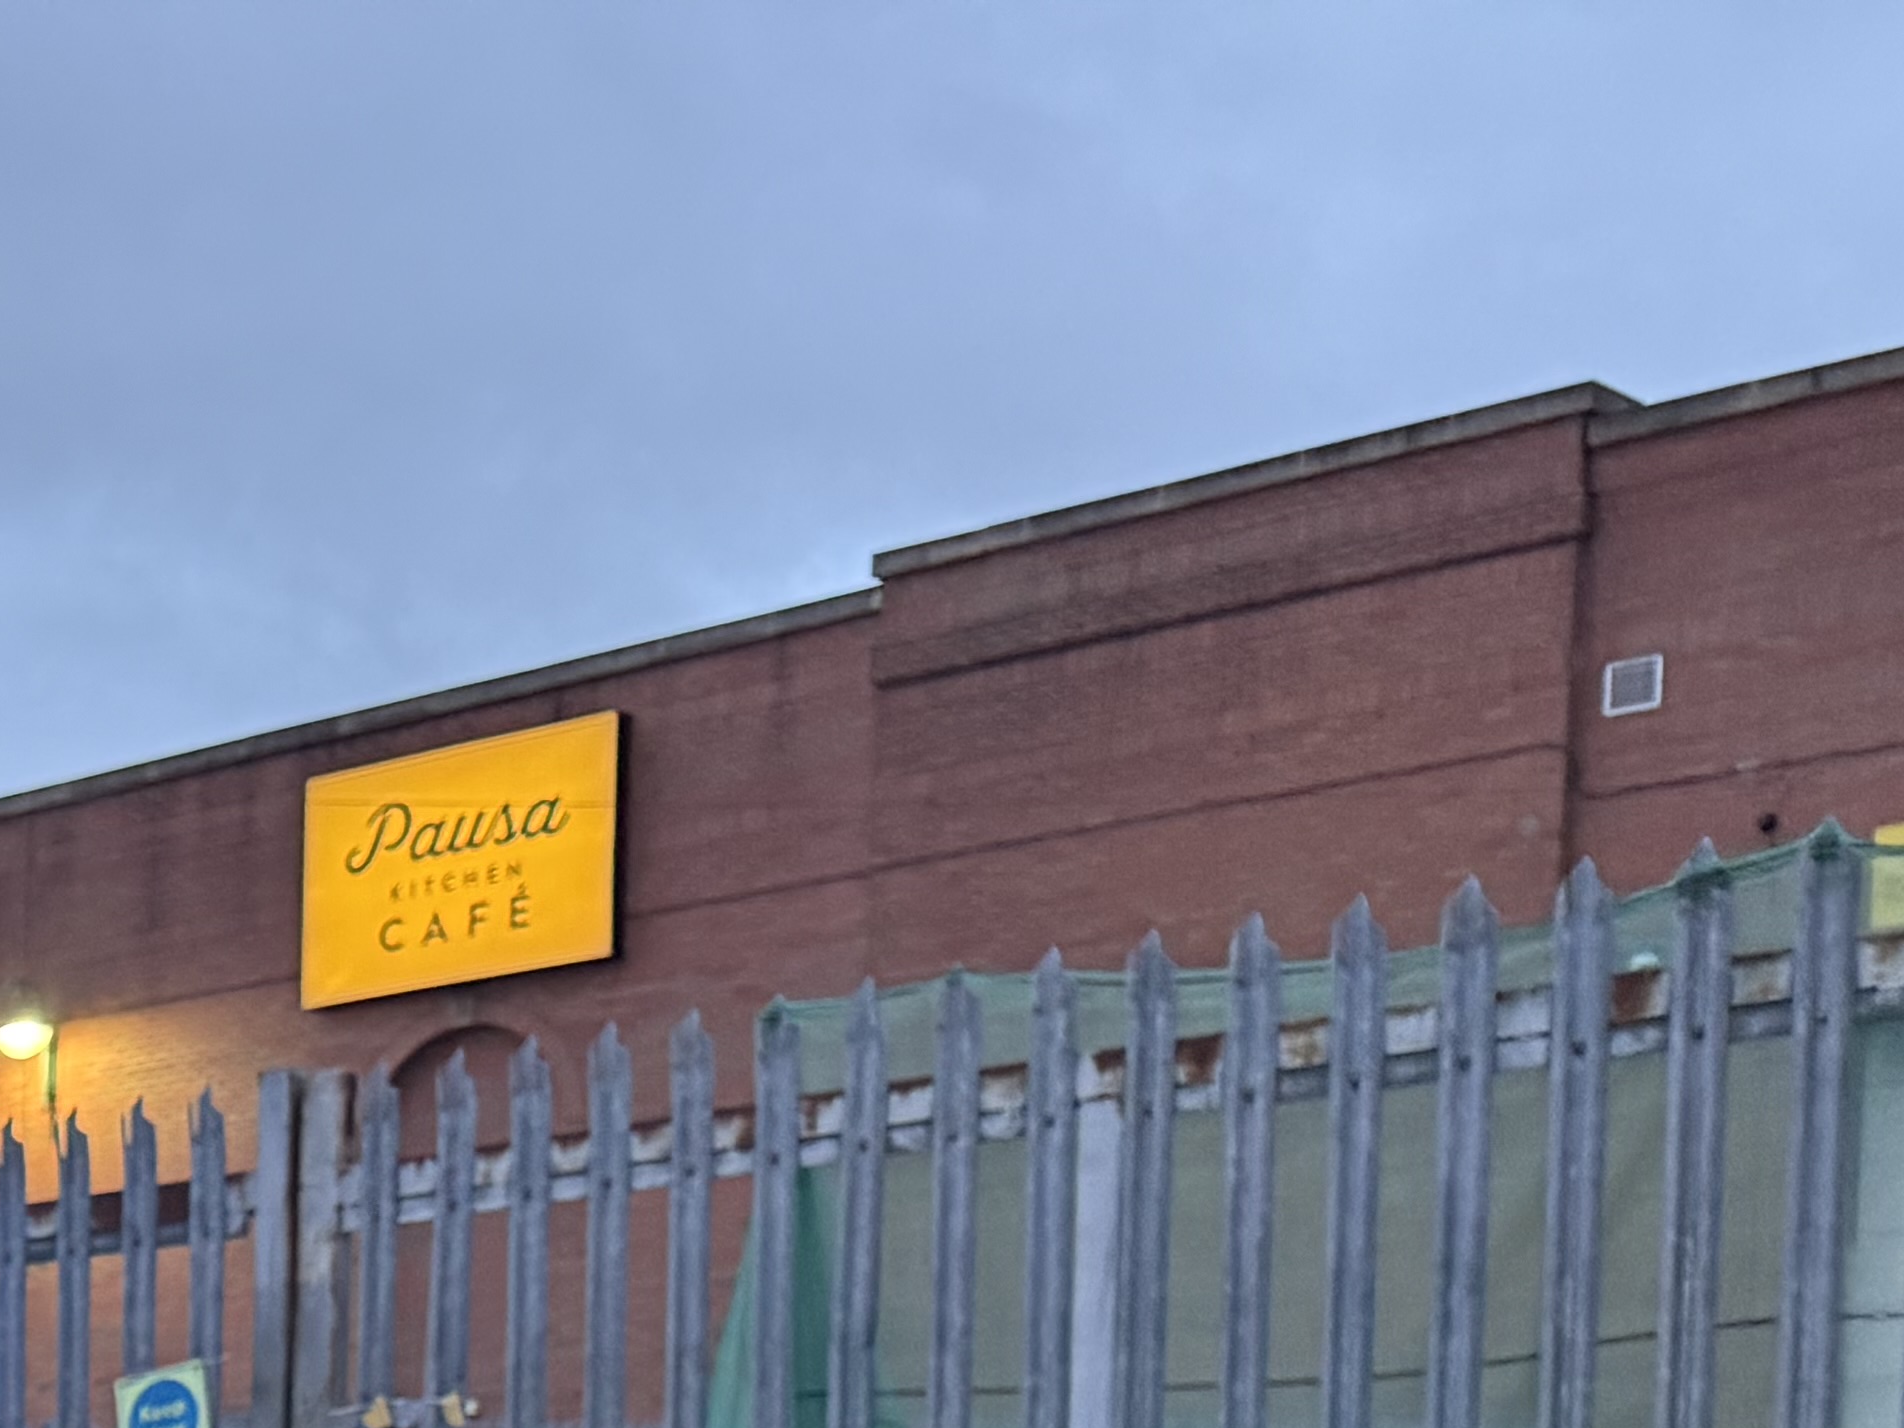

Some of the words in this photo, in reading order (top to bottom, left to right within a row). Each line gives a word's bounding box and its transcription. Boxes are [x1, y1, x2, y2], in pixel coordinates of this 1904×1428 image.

[345, 793, 571, 875] Pausa
[389, 860, 523, 902] KITCHEN
[378, 883, 532, 952] CAFÉ
